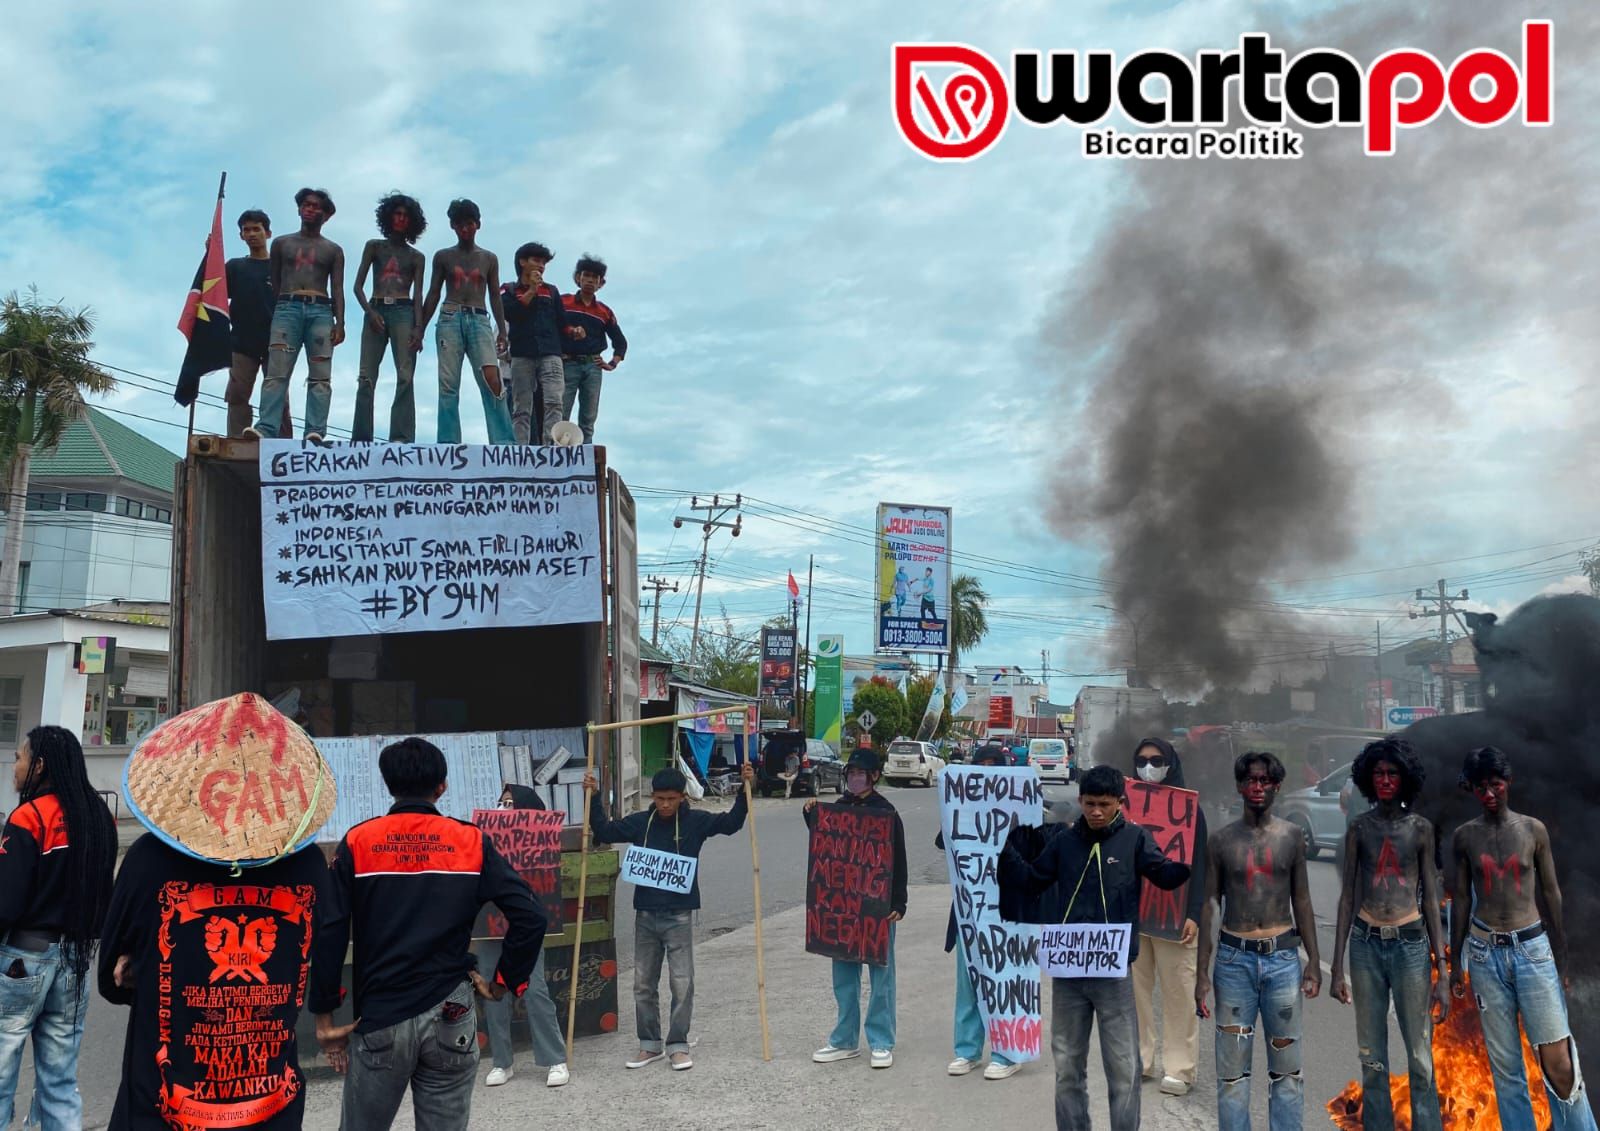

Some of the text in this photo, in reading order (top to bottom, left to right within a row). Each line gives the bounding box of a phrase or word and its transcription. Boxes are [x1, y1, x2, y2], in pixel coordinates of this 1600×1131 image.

[381, 256, 405, 283] A
[454, 265, 481, 290] M
[271, 450, 370, 477] GERAKAN
[381, 445, 468, 471] AKTIVIS
[273, 485, 357, 504] PRABOWO
[363, 482, 454, 499] PELANGGAR
[462, 484, 505, 500] HAM
[562, 482, 596, 496] LALU
[393, 499, 507, 518] PELANGGARAN
[511, 500, 540, 514] HAM
[544, 501, 560, 514] DI
[293, 542, 354, 562] POLISI
[354, 537, 418, 560] TAKUT
[477, 534, 518, 556] FIRLI
[520, 531, 583, 556] BAHURI
[295, 526, 383, 543] INDONESIA
[888, 541, 909, 551] MARI
[884, 551, 912, 561] PALOPO
[293, 556, 596, 588] SAHKAN RUU PERAMPASAN ASET
[944, 772, 1044, 805] MENOLAK
[199, 768, 310, 836] GAM
[477, 811, 566, 830] HUKUM MATI
[817, 806, 894, 840] KORUPSI
[511, 829, 561, 848] PELAKU
[812, 832, 848, 858] DAN
[626, 850, 692, 876] HUKUM MATI
[1246, 848, 1274, 892] H
[1373, 836, 1406, 890] A
[1480, 853, 1522, 897] M
[629, 863, 688, 889] KORUPTOR
[815, 884, 863, 914] KAN
[807, 908, 890, 962] NEGARA
[1042, 929, 1126, 950] HUKUM MATI
[229, 953, 252, 966] KIRI
[1048, 950, 1121, 975] KORUPTOR
[182, 986, 206, 996] JIKA
[209, 986, 248, 997] HATIMU
[186, 994, 289, 1008] MELIHAT PENINDASAN
[191, 1019, 284, 1035] JIWAMU BERONTAK
[226, 1007, 253, 1023] DAN
[185, 1030, 289, 1047] PADA KETIDAKADILAN
[194, 1042, 280, 1064] MAKA KAU
[205, 1059, 267, 1081] ADALAH
[194, 1074, 279, 1100] KAWANKU
